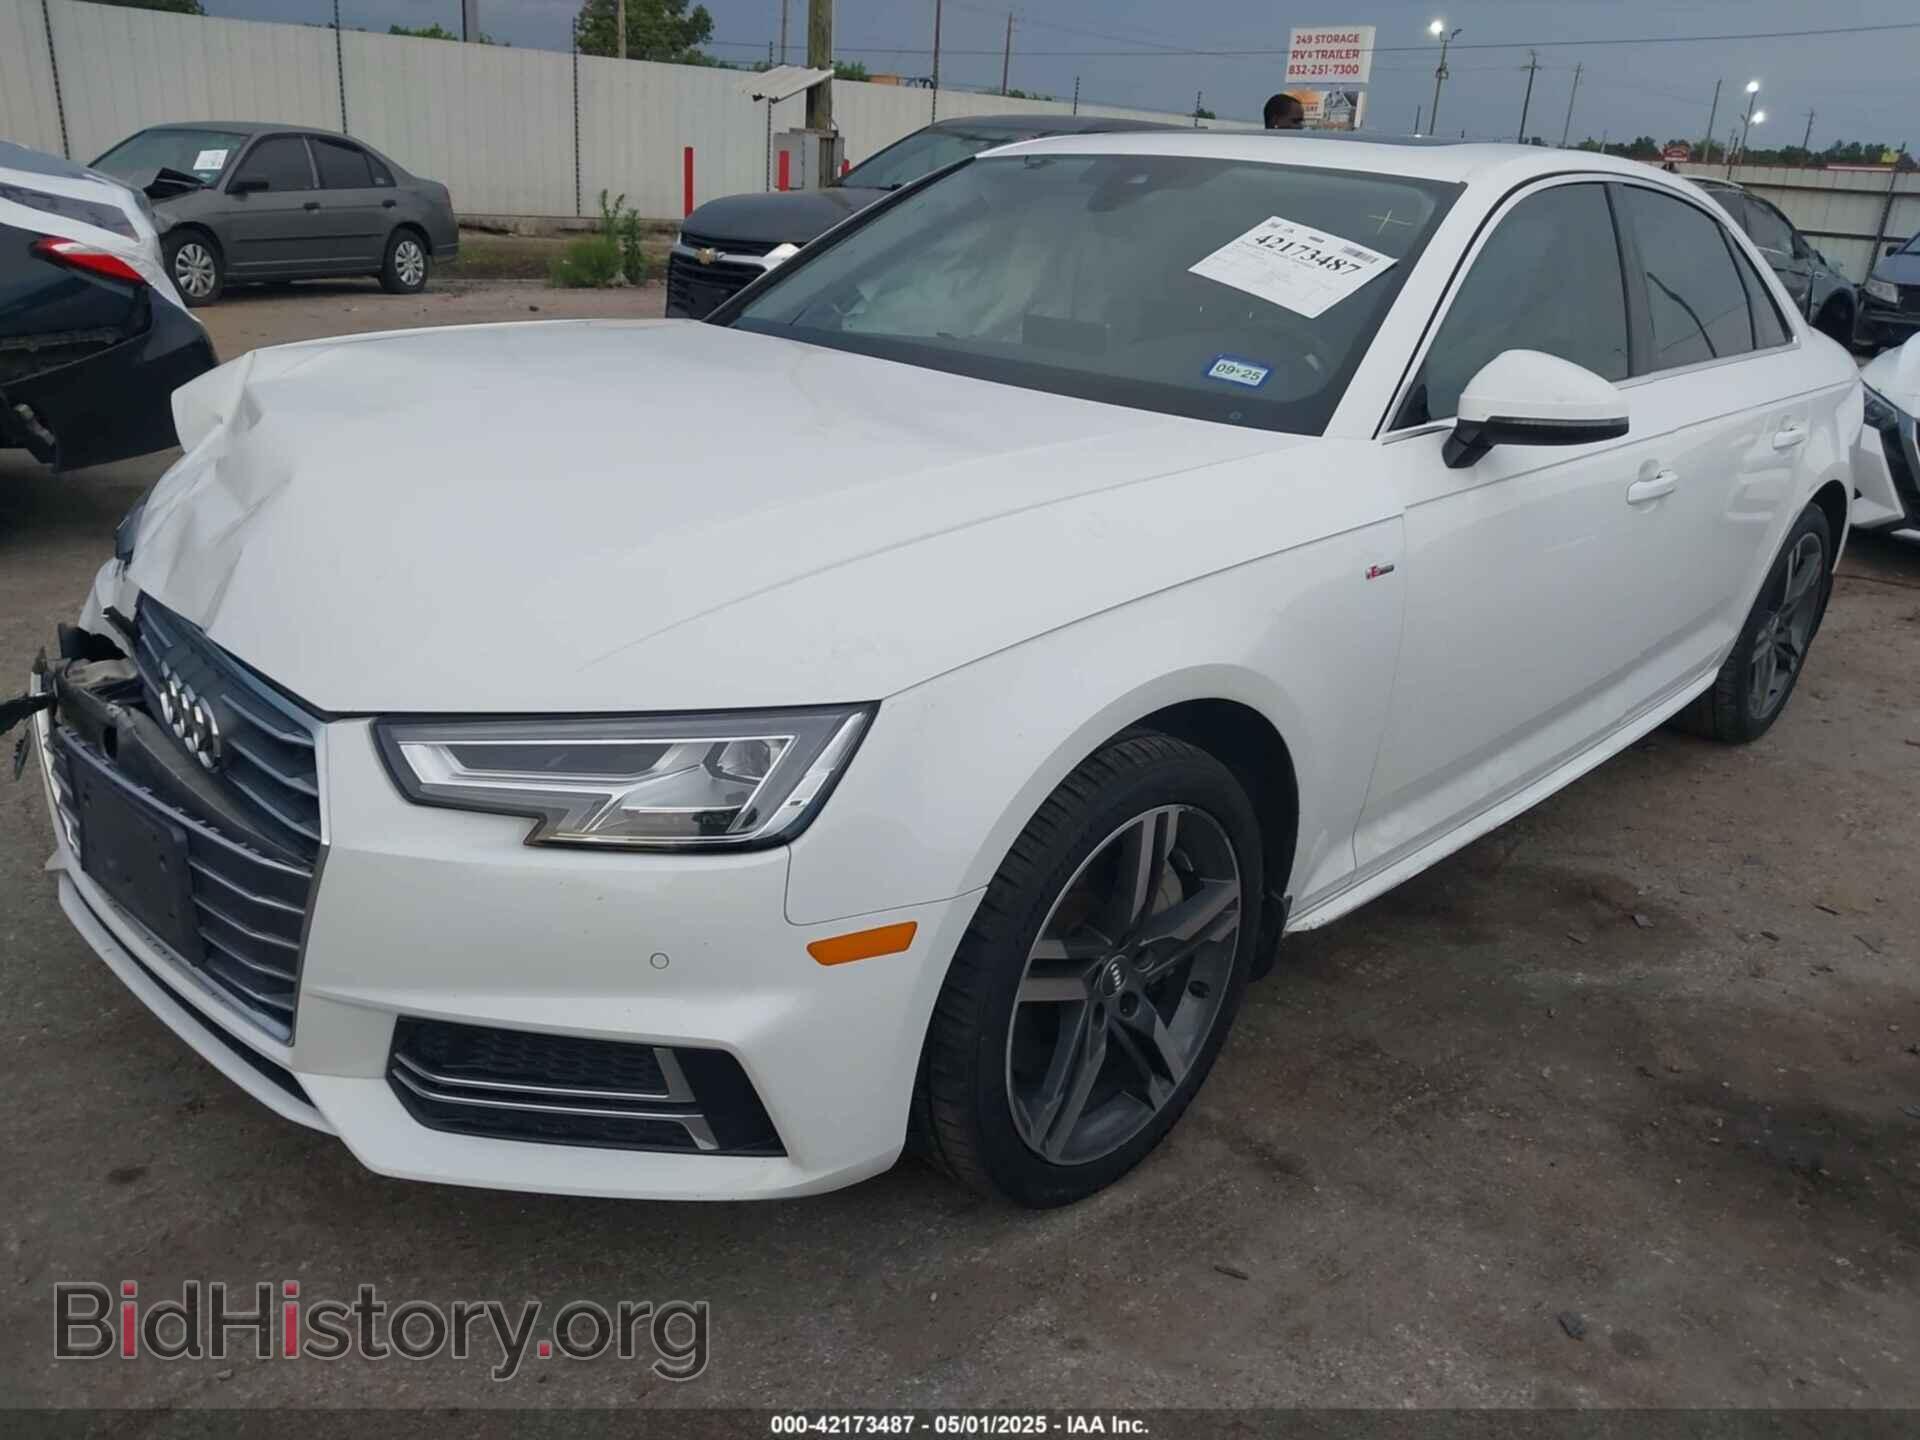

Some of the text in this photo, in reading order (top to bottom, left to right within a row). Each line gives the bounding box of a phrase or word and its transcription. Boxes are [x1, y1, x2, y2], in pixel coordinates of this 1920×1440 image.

[1296, 33, 1360, 44] 249 STORAGE
[1292, 50, 1307, 59] RV
[1315, 49, 1360, 59] TRAILER
[1288, 64, 1359, 75] 832-251-7300
[1255, 234, 1361, 275] 42173487
